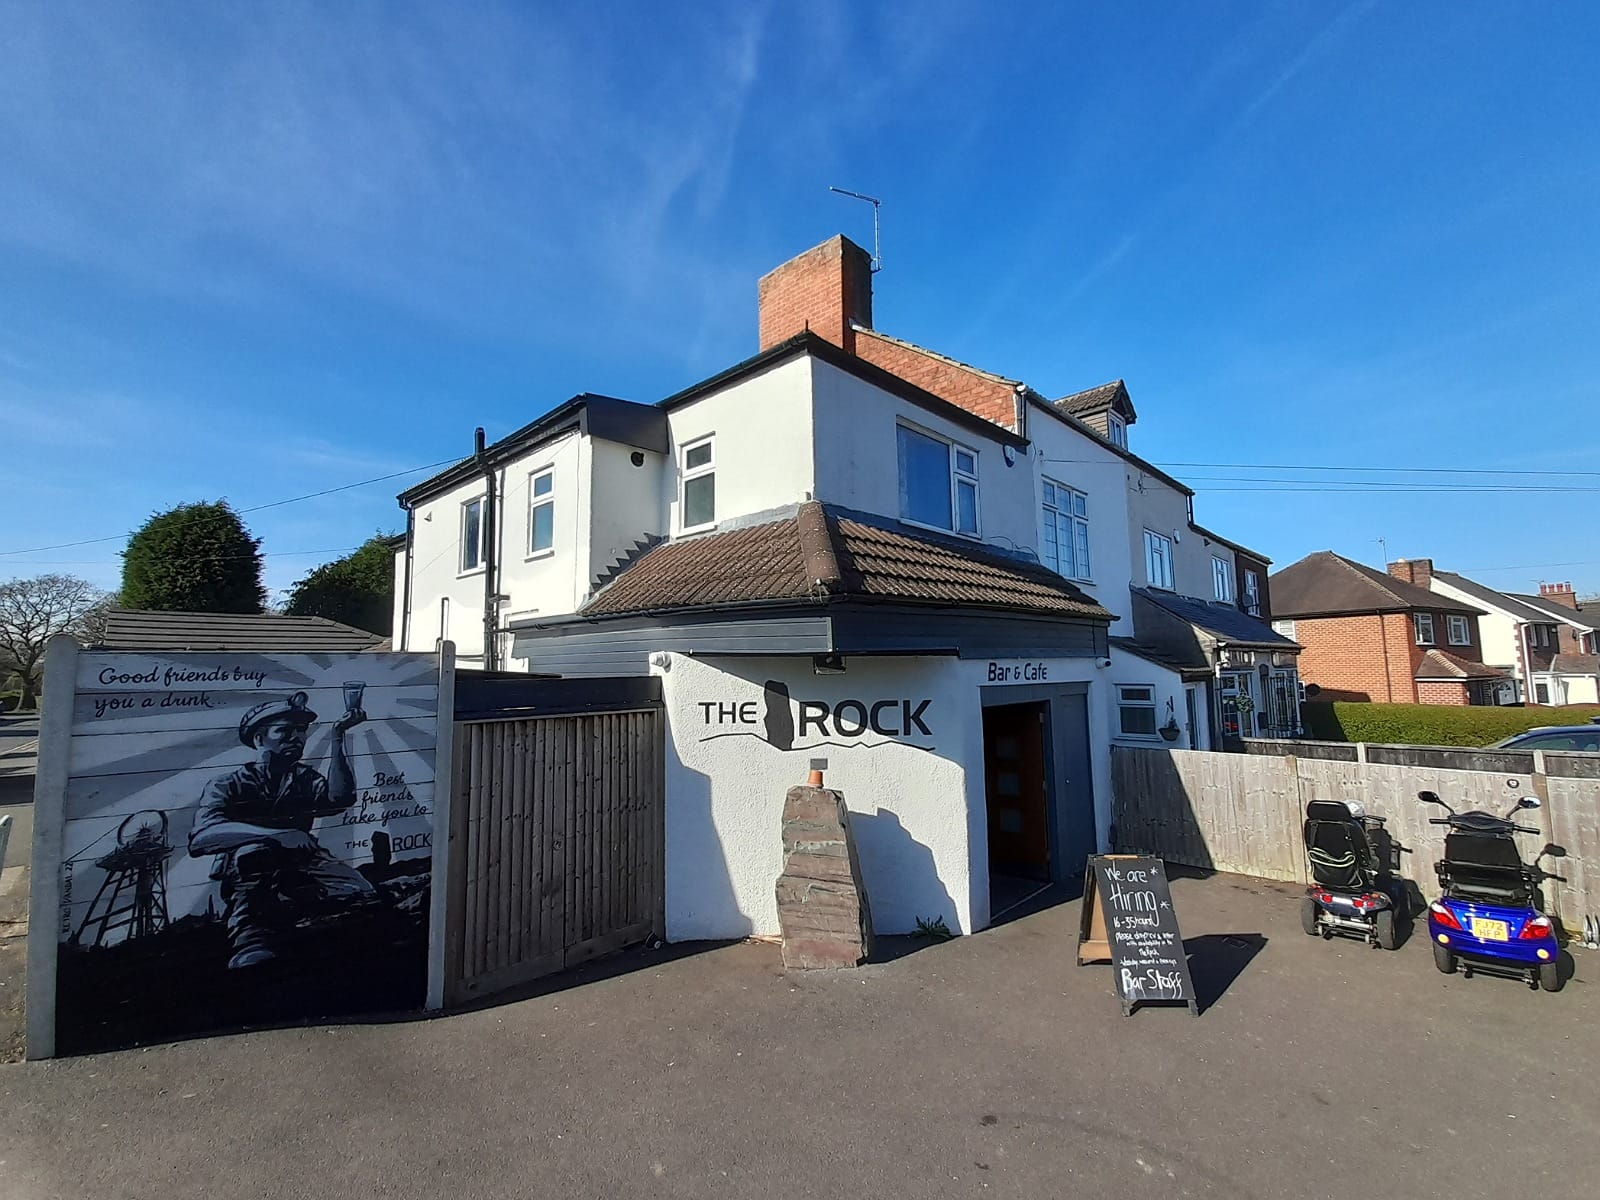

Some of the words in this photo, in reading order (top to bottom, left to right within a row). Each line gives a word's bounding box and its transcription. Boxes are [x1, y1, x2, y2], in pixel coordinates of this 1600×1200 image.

[98, 666, 159, 684] Good
[164, 665, 229, 687] friends
[233, 666, 267, 687] buy
[988, 662, 1011, 681] Bar
[1014, 666, 1021, 680] &
[1024, 662, 1047, 680] Cafe
[95, 699, 134, 718] you
[141, 698, 154, 708] a
[698, 701, 758, 725] THE
[799, 699, 933, 737] ROCK
[373, 771, 405, 786] Best
[362, 786, 414, 810] friends
[342, 809, 377, 825] take
[381, 808, 409, 827] you
[414, 803, 428, 816] to
[345, 839, 369, 849] THE
[391, 832, 432, 852] ROCK
[1104, 861, 1126, 881] We
[1127, 869, 1149, 883] are
[1109, 883, 1159, 927] Hiring
[1475, 919, 1504, 931] FJ72
[1479, 929, 1502, 939] HFP
[1121, 968, 1147, 994] Bar
[1147, 969, 1183, 998] Staff
